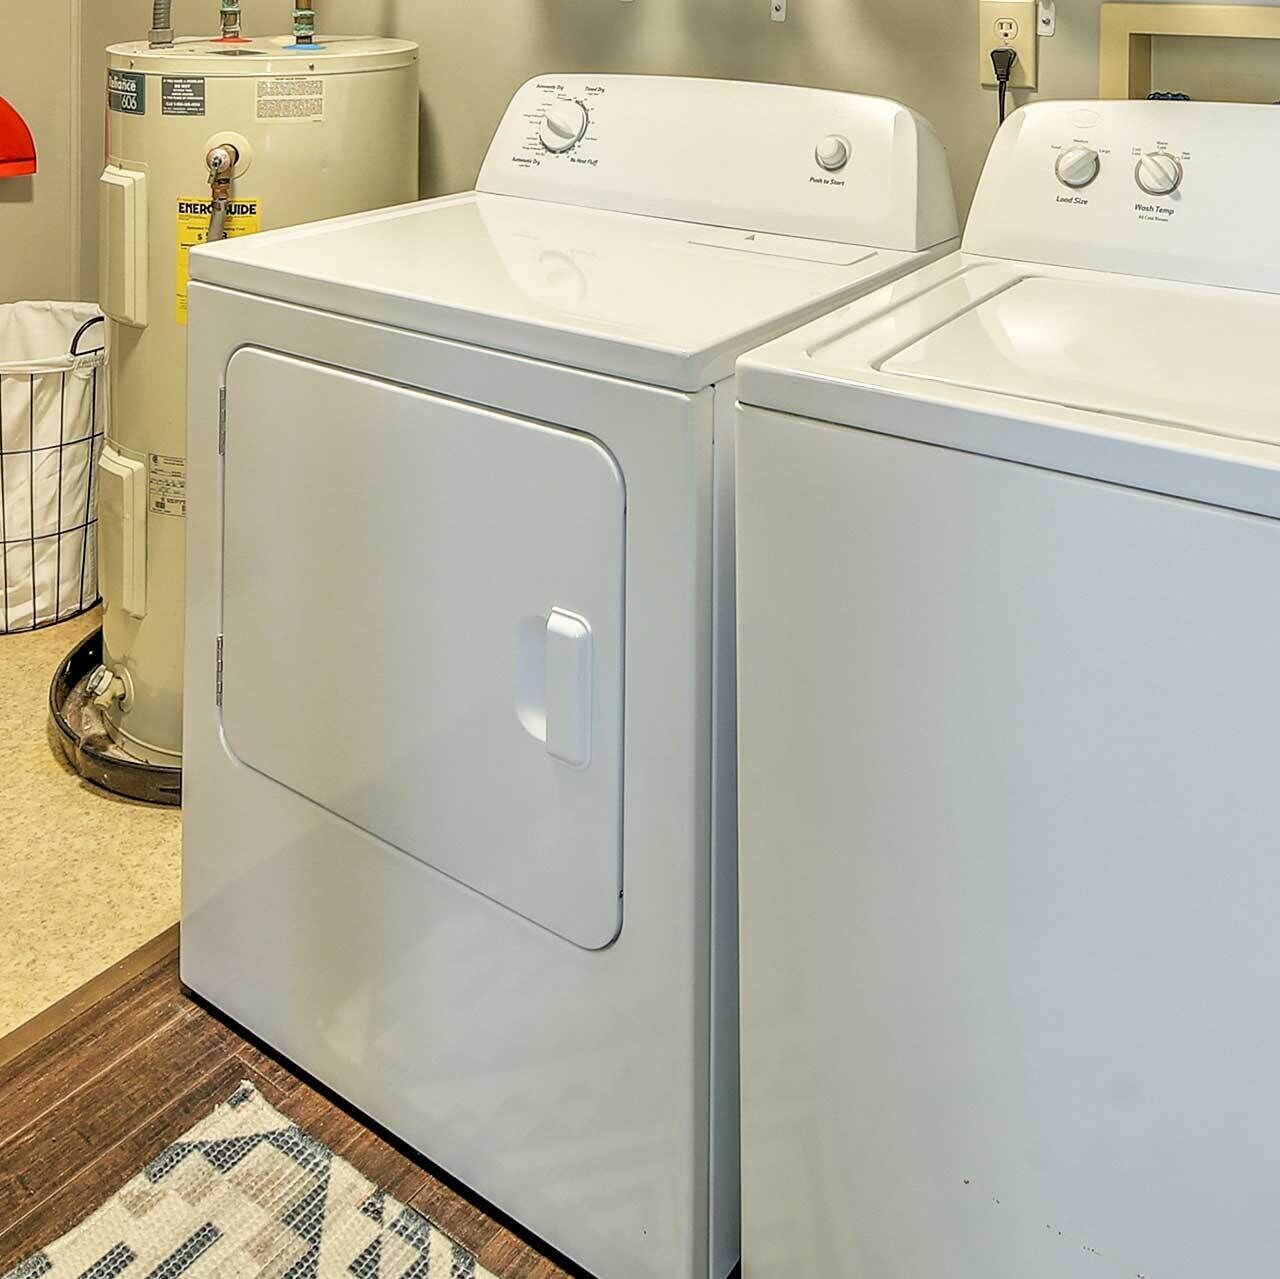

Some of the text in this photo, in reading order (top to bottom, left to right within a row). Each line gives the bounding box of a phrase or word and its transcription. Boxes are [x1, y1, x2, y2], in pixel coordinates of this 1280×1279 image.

[122, 95, 137, 109] 606
[1056, 196, 1088, 205] Load Size
[1135, 204, 1174, 216] Wash Temp
